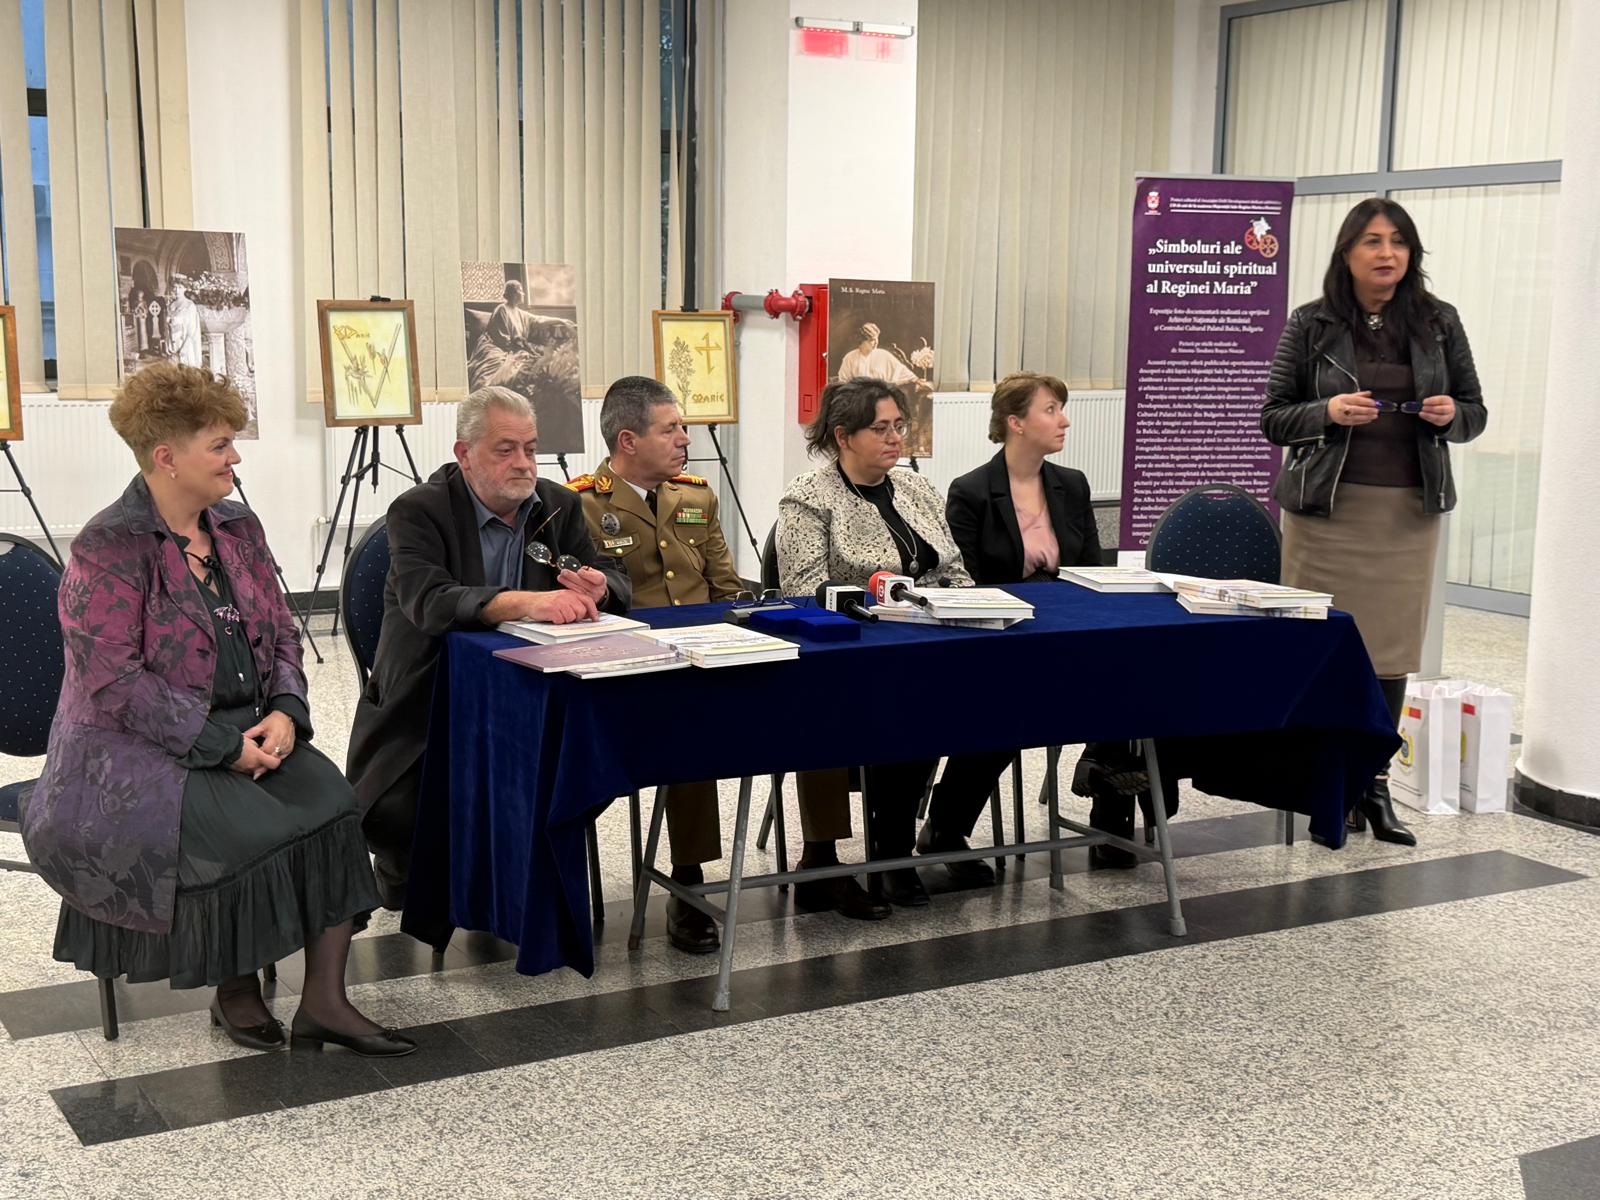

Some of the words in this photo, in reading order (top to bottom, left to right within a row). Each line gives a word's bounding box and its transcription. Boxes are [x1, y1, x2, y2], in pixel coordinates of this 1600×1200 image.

[1148, 239, 1220, 255] „Simboluri
[1222, 242, 1243, 255] ale
[1148, 260, 1221, 275] universului
[1223, 261, 1277, 278] spiritual
[1146, 281, 1158, 295] al
[1161, 281, 1210, 298] Reginei
[1213, 281, 1258, 295] Maria”
